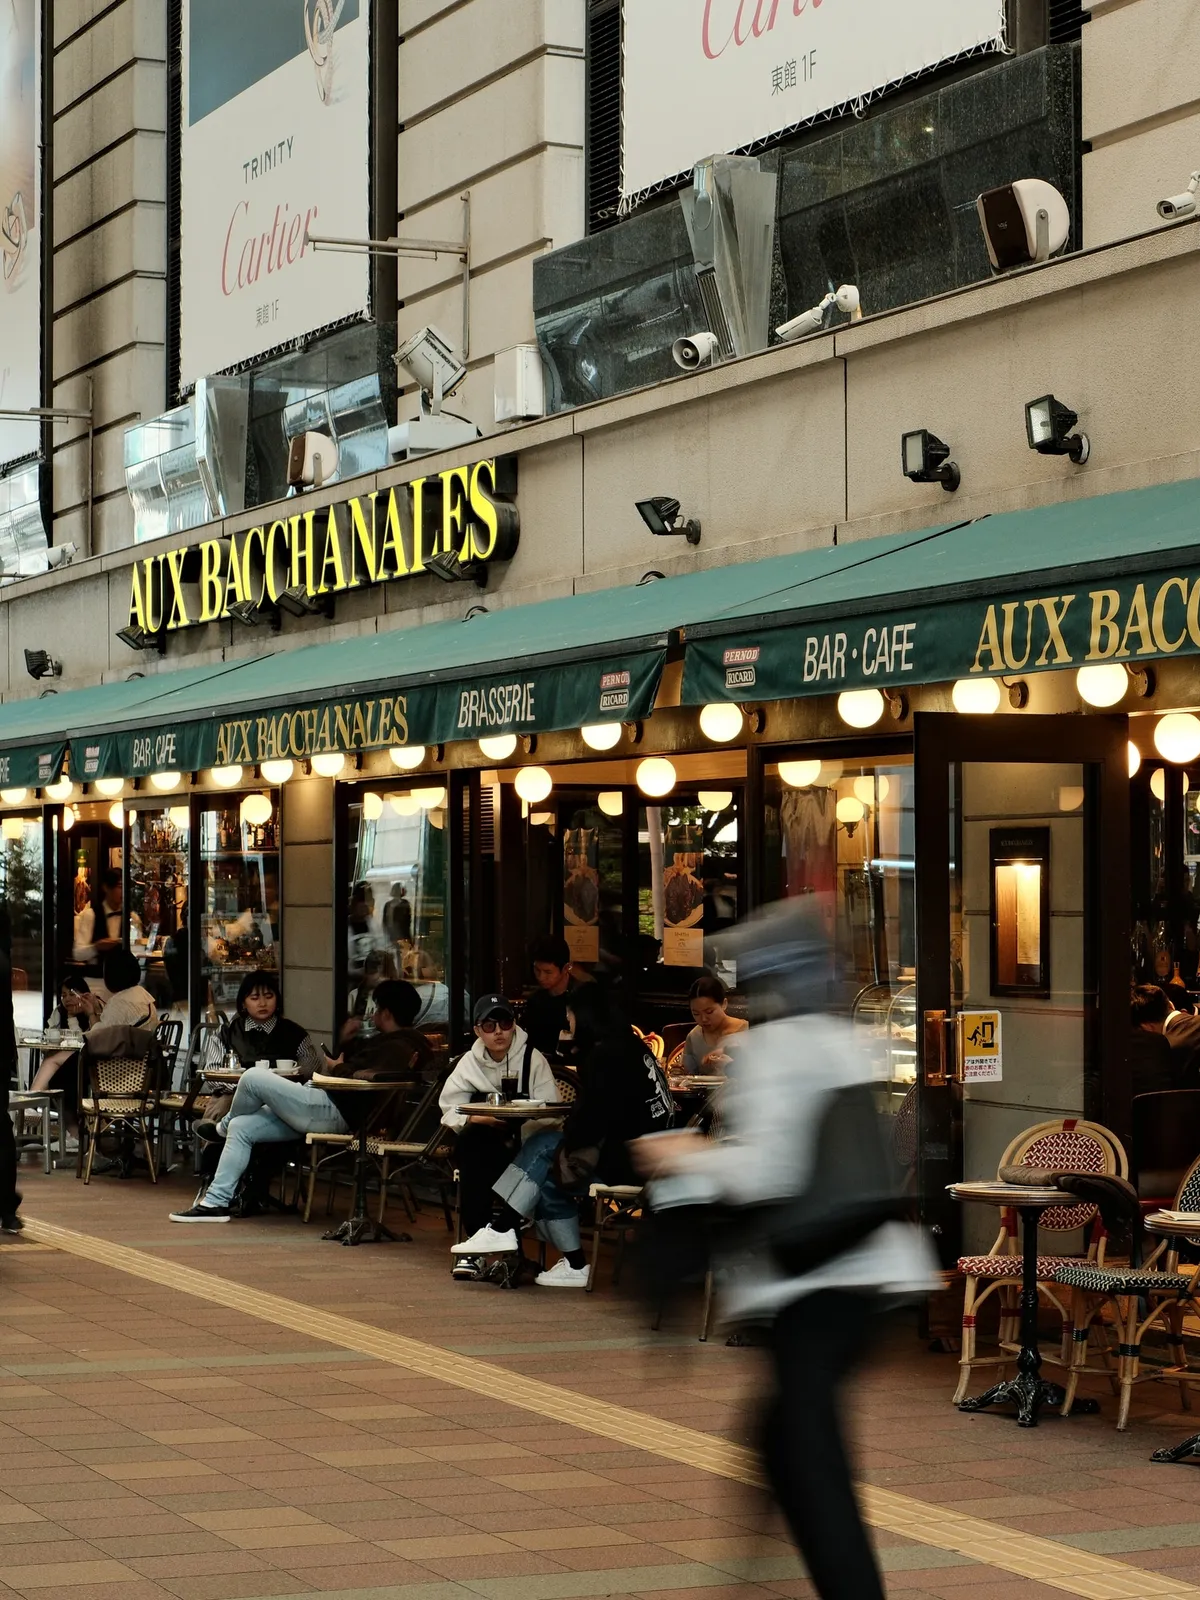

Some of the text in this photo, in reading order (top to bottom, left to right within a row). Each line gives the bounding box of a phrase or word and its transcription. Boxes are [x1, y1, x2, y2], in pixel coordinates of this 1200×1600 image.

[771, 49, 817, 96] 東館 1F
[243, 136, 294, 184] TRINITY
[222, 201, 318, 296] Cartier
[271, 299, 279, 321] 1F
[128, 460, 498, 634] AUX BACCHANALES
[724, 649, 758, 662] PERNOD
[969, 593, 1076, 673] AUX
[602, 692, 628, 707] RICARD
[727, 671, 754, 685] RICARD
[457, 683, 535, 728] BRASSERIE
[214, 696, 409, 765] AUX BACCHANALES
